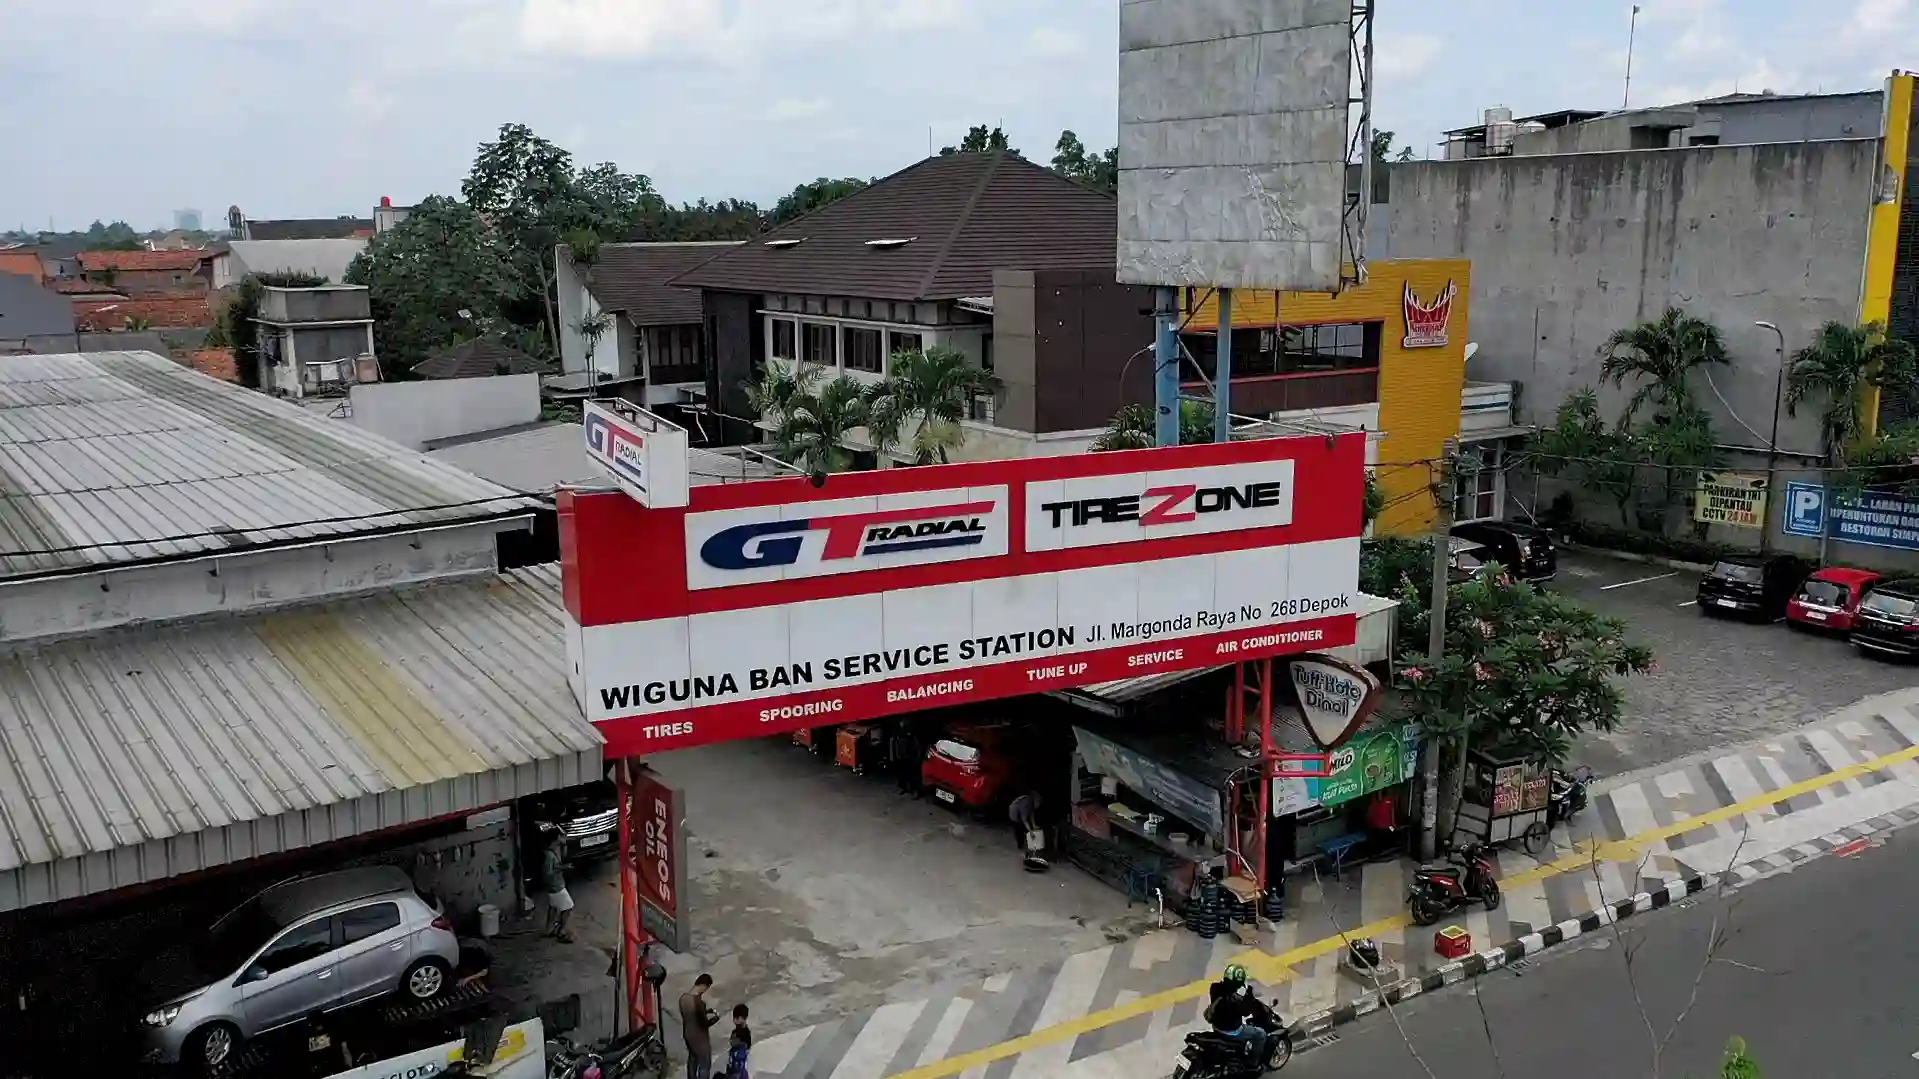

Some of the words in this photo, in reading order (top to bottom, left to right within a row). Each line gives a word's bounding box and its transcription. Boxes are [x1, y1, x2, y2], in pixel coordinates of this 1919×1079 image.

[585, 412, 643, 461] GT
[615, 441, 642, 466] RADIAL
[1702, 508, 1726, 520] CCTV
[1795, 491, 1820, 519] P
[700, 500, 996, 570] GT
[866, 517, 987, 543] RADIAL
[1840, 522, 1891, 538] RESTORAN
[600, 672, 739, 710] WIGUNA
[749, 661, 813, 691] BAN
[823, 643, 949, 680] SERVICE
[958, 625, 1075, 660] STATION
[1086, 624, 1106, 643] Jl.
[1111, 613, 1193, 640] Margonda
[1196, 610, 1237, 631] Raya
[1240, 604, 1262, 622] No
[1270, 599, 1297, 618] 268
[1299, 593, 1350, 614] Depok
[1216, 640, 1238, 654] AIR
[1241, 629, 1324, 650] CONDITIONER
[1127, 648, 1184, 668] SERVICE
[1026, 665, 1065, 681] TUNE
[1067, 662, 1089, 675] UP
[886, 680, 974, 702] BALANCING
[759, 699, 844, 722] SPOORING
[642, 721, 694, 739] TIRES
[645, 820, 656, 857] OIL
[654, 797, 671, 902] ENEOS
